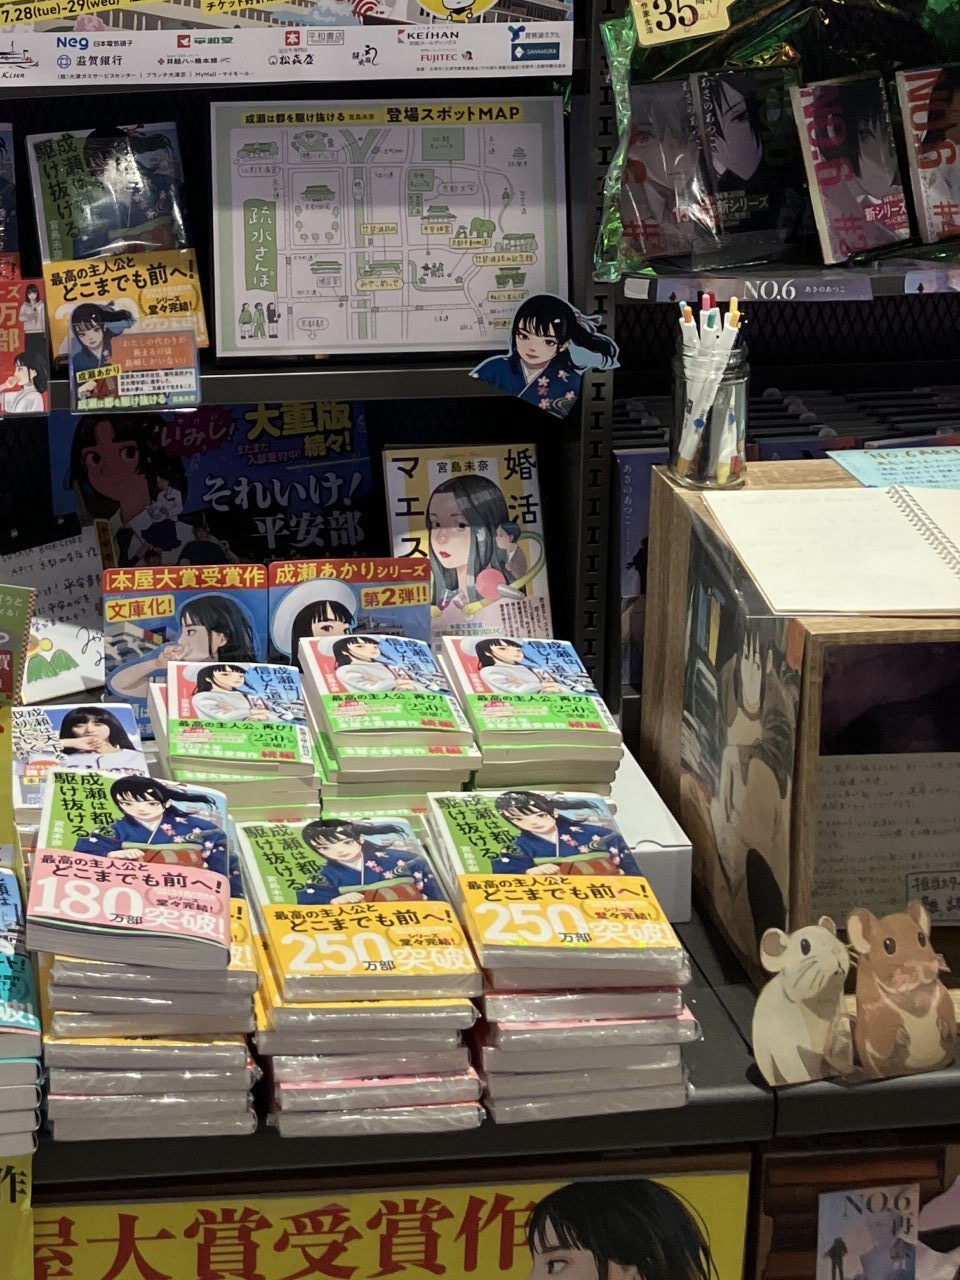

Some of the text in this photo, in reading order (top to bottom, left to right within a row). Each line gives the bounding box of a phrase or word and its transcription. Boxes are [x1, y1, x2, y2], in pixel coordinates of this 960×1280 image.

[386, 105, 521, 123] 登場スポットMAP
[743, 280, 797, 300] NO.6
[436, 460, 489, 473] 宮島未奈
[202, 471, 363, 511] それいけ!
[504, 447, 539, 524] 婚活
[251, 509, 365, 550] 平安部
[275, 560, 426, 585] 成瀬あかりシリーズ
[108, 597, 175, 619] 文庫化!
